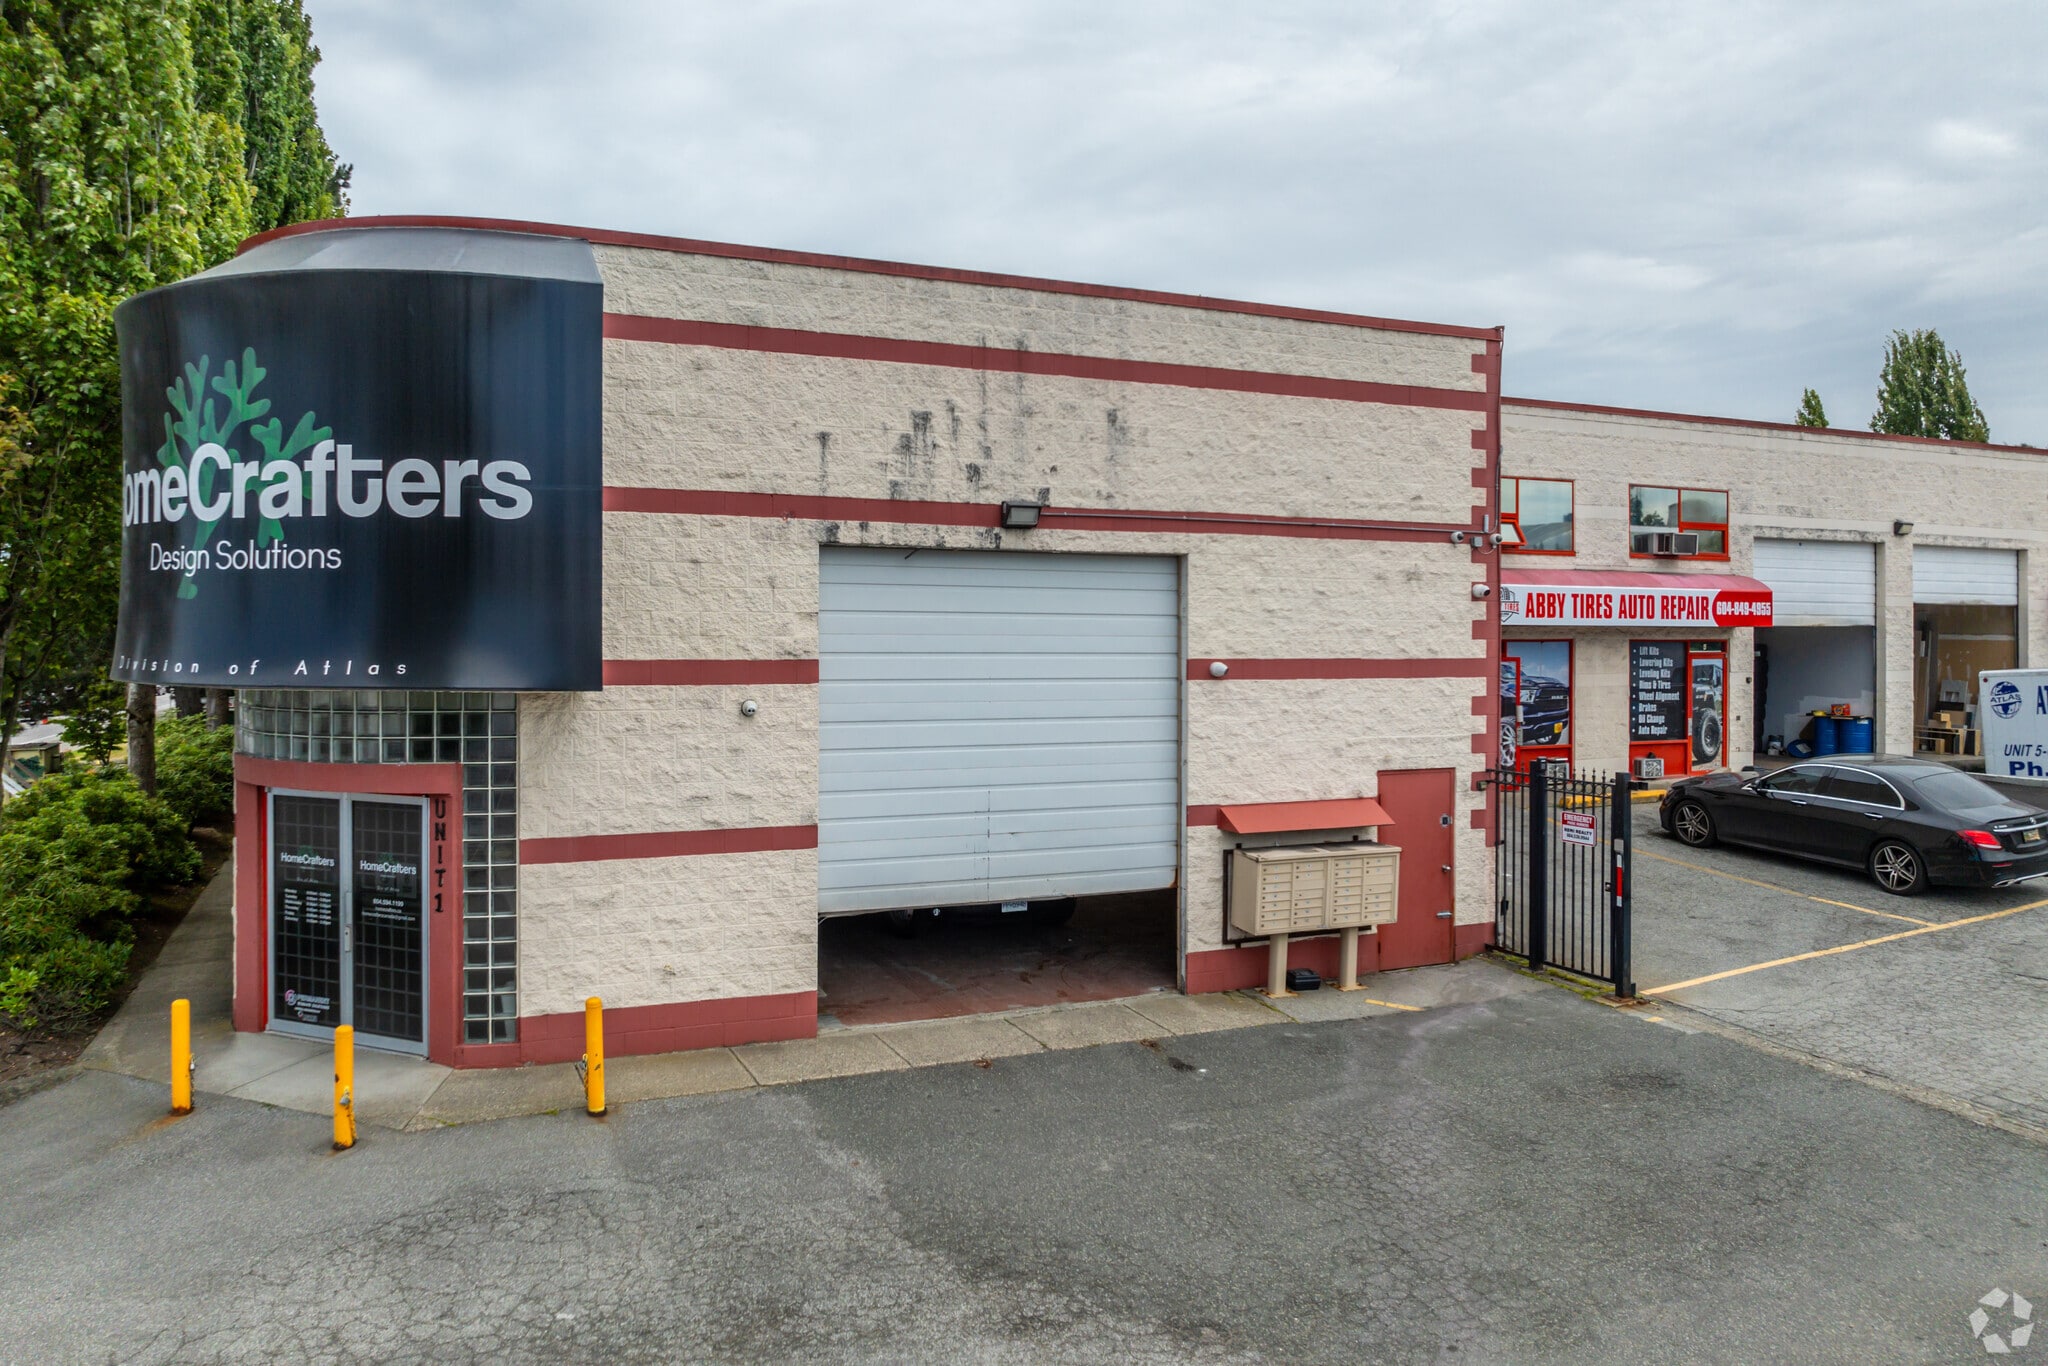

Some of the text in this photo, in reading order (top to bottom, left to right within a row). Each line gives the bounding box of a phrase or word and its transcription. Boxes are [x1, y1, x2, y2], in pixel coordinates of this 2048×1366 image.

[123, 439, 534, 527] omeCrafters
[150, 539, 342, 577] Design Solutions
[1525, 592, 1772, 620] ABBY TIRES AUTO REPAIR 604-849-4955
[228, 659, 260, 675] of
[294, 659, 407, 676] Atlas
[1663, 658, 1673, 667] Kits
[1661, 669, 1671, 678] Kits
[1990, 694, 2022, 703] ATLAS
[2004, 744, 2033, 757] UNIT
[280, 852, 335, 867] HomeCrafters
[434, 799, 447, 913] UNIT 1
[360, 860, 417, 875] HomeCrafters
